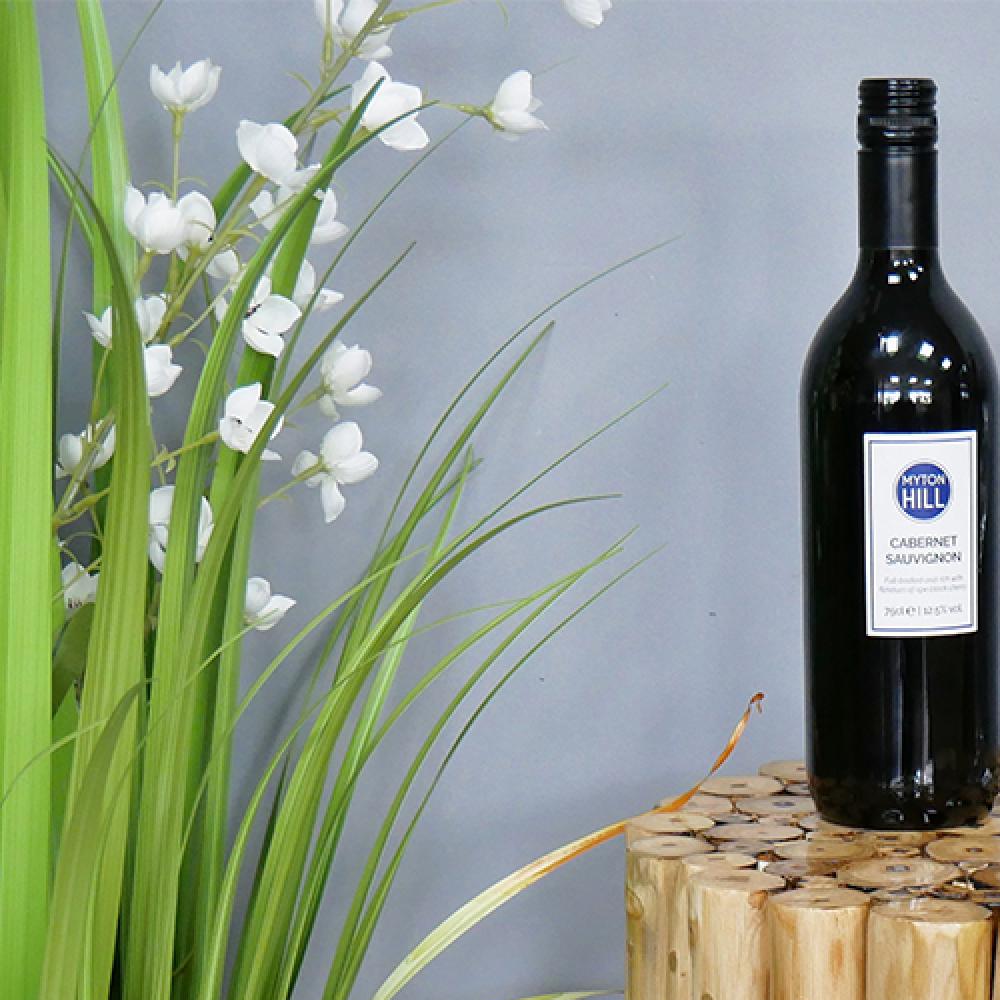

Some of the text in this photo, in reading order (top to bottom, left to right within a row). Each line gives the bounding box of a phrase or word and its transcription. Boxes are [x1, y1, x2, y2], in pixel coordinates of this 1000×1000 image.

[902, 487, 945, 509] HILL
[889, 535, 957, 549] CABERNET
[885, 552, 962, 565] SAUVIGNON
